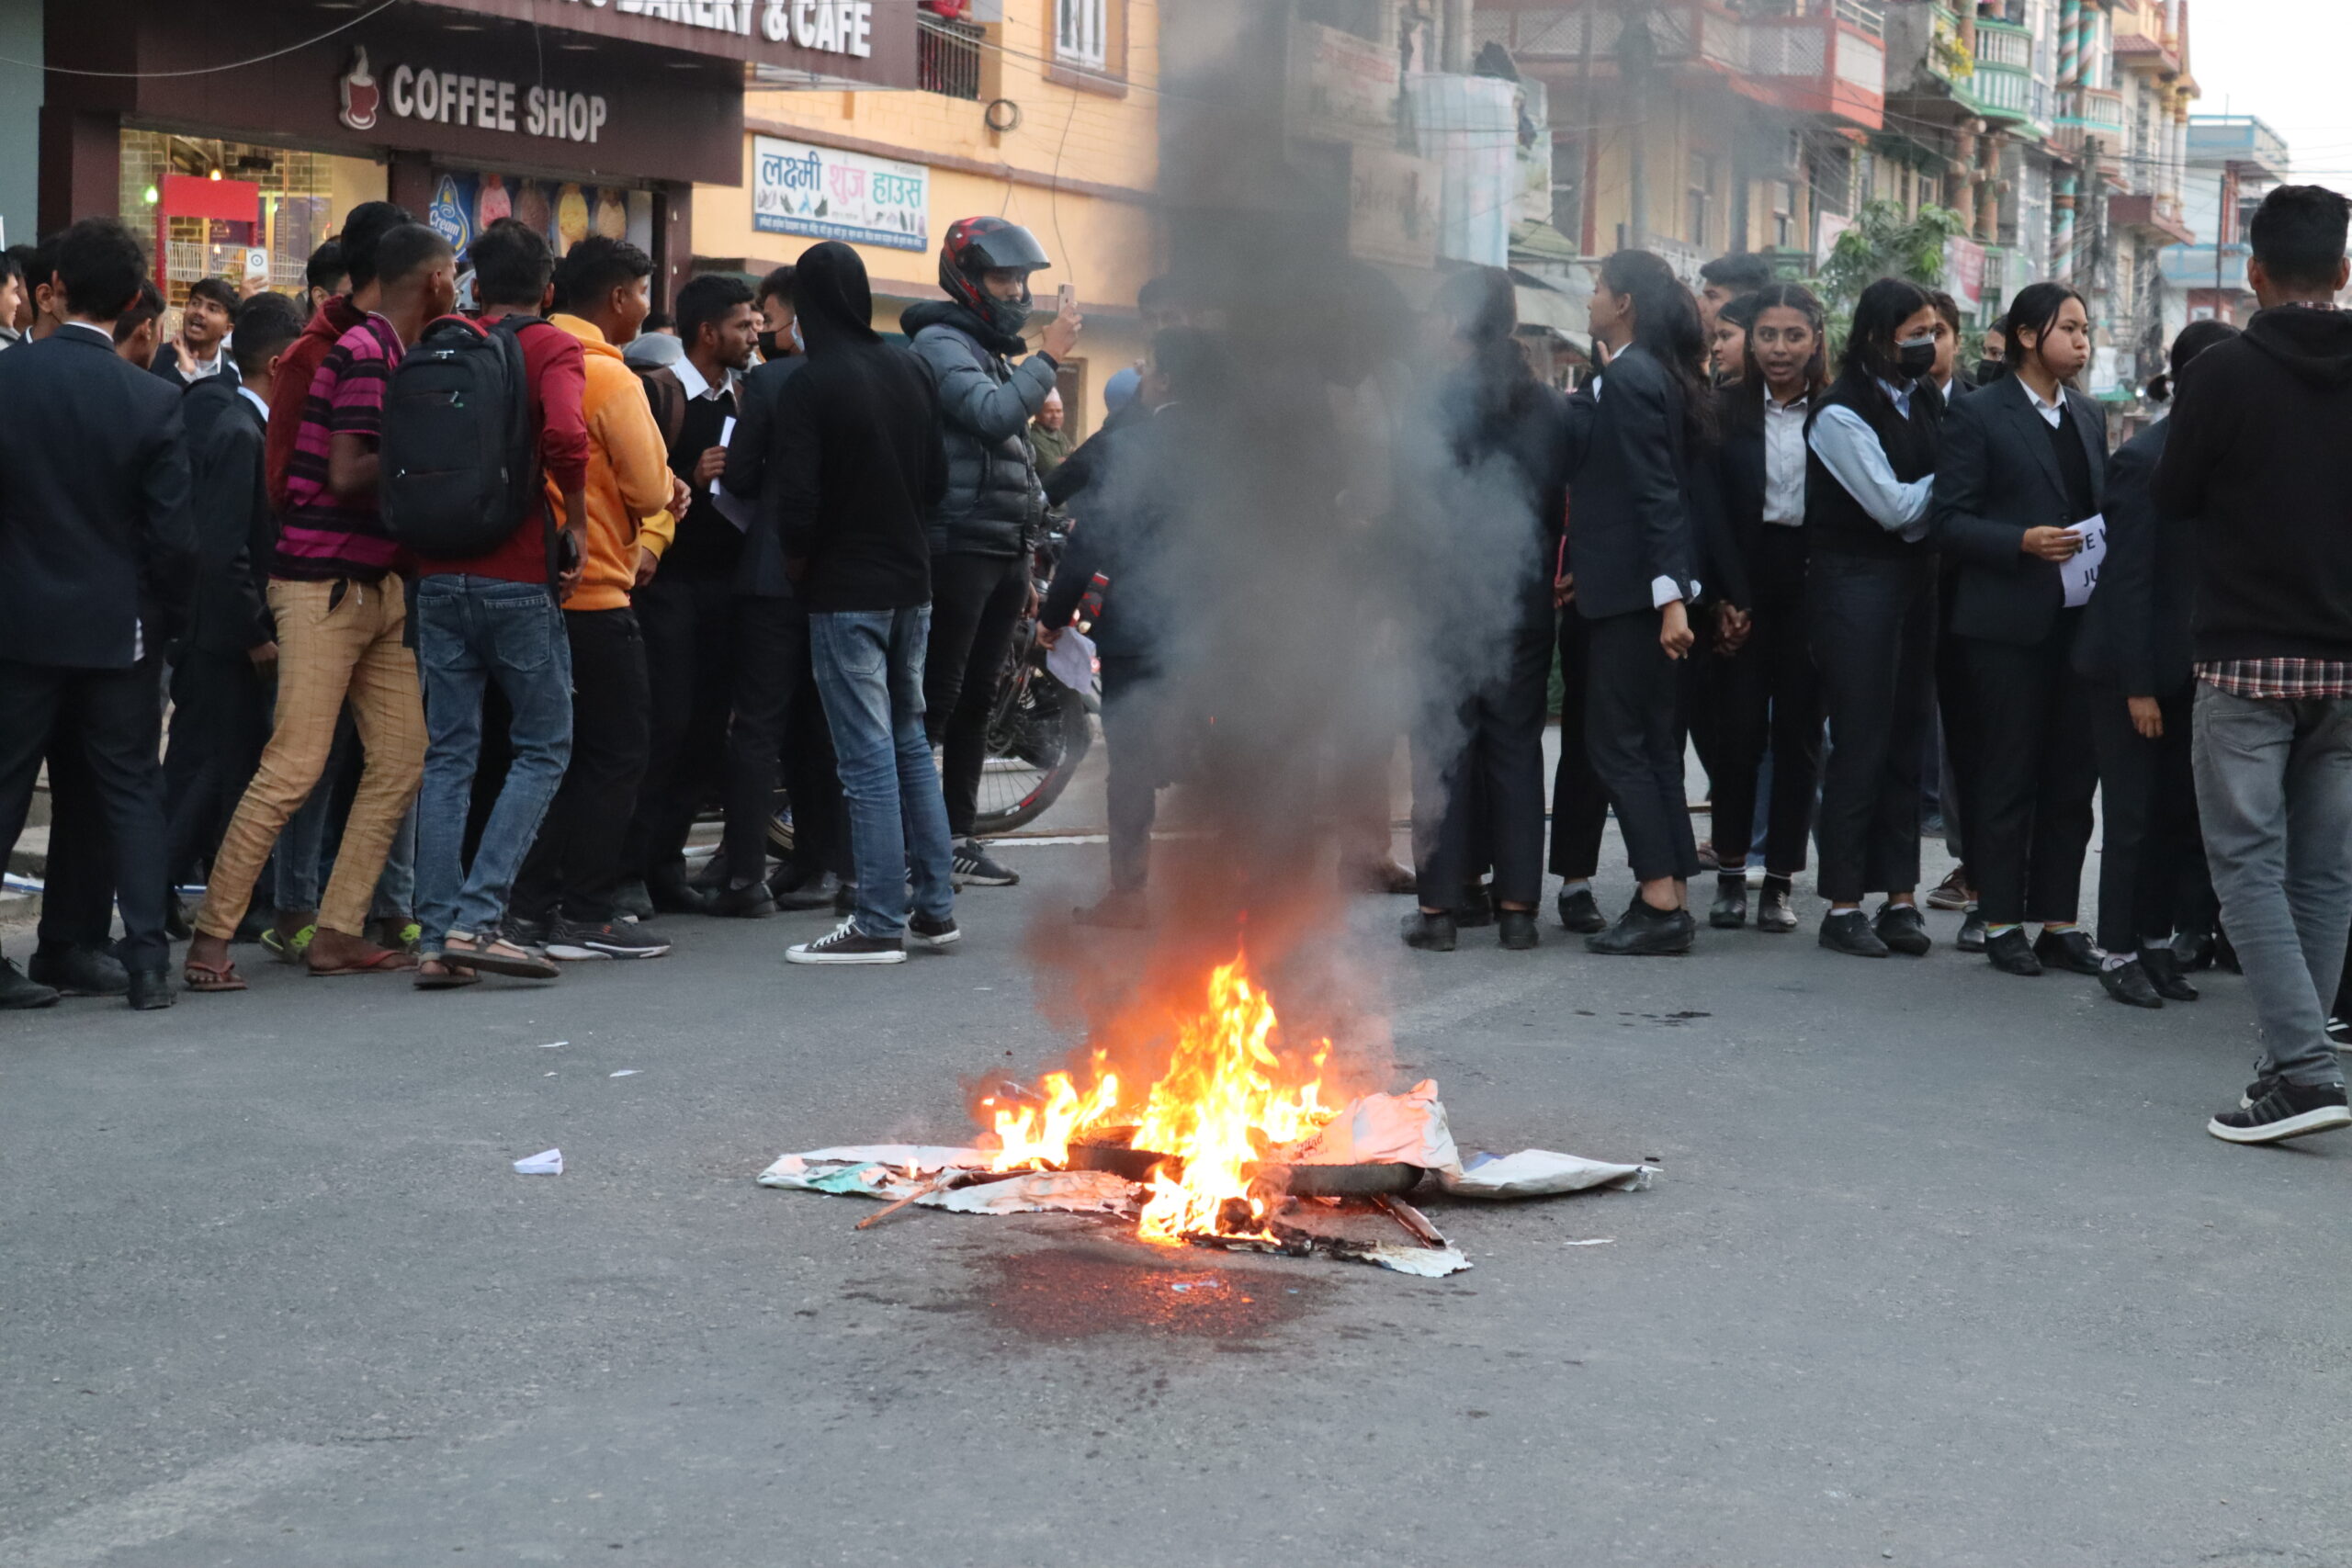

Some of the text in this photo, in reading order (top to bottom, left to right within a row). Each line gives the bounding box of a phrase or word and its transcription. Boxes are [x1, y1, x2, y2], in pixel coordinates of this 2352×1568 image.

[791, 0, 872, 58] CAFE
[390, 63, 607, 143] COFFEE SHOP
[762, 150, 823, 192] लक्ष्मी
[873, 171, 923, 209] हाउस
[430, 209, 460, 236] Cream
